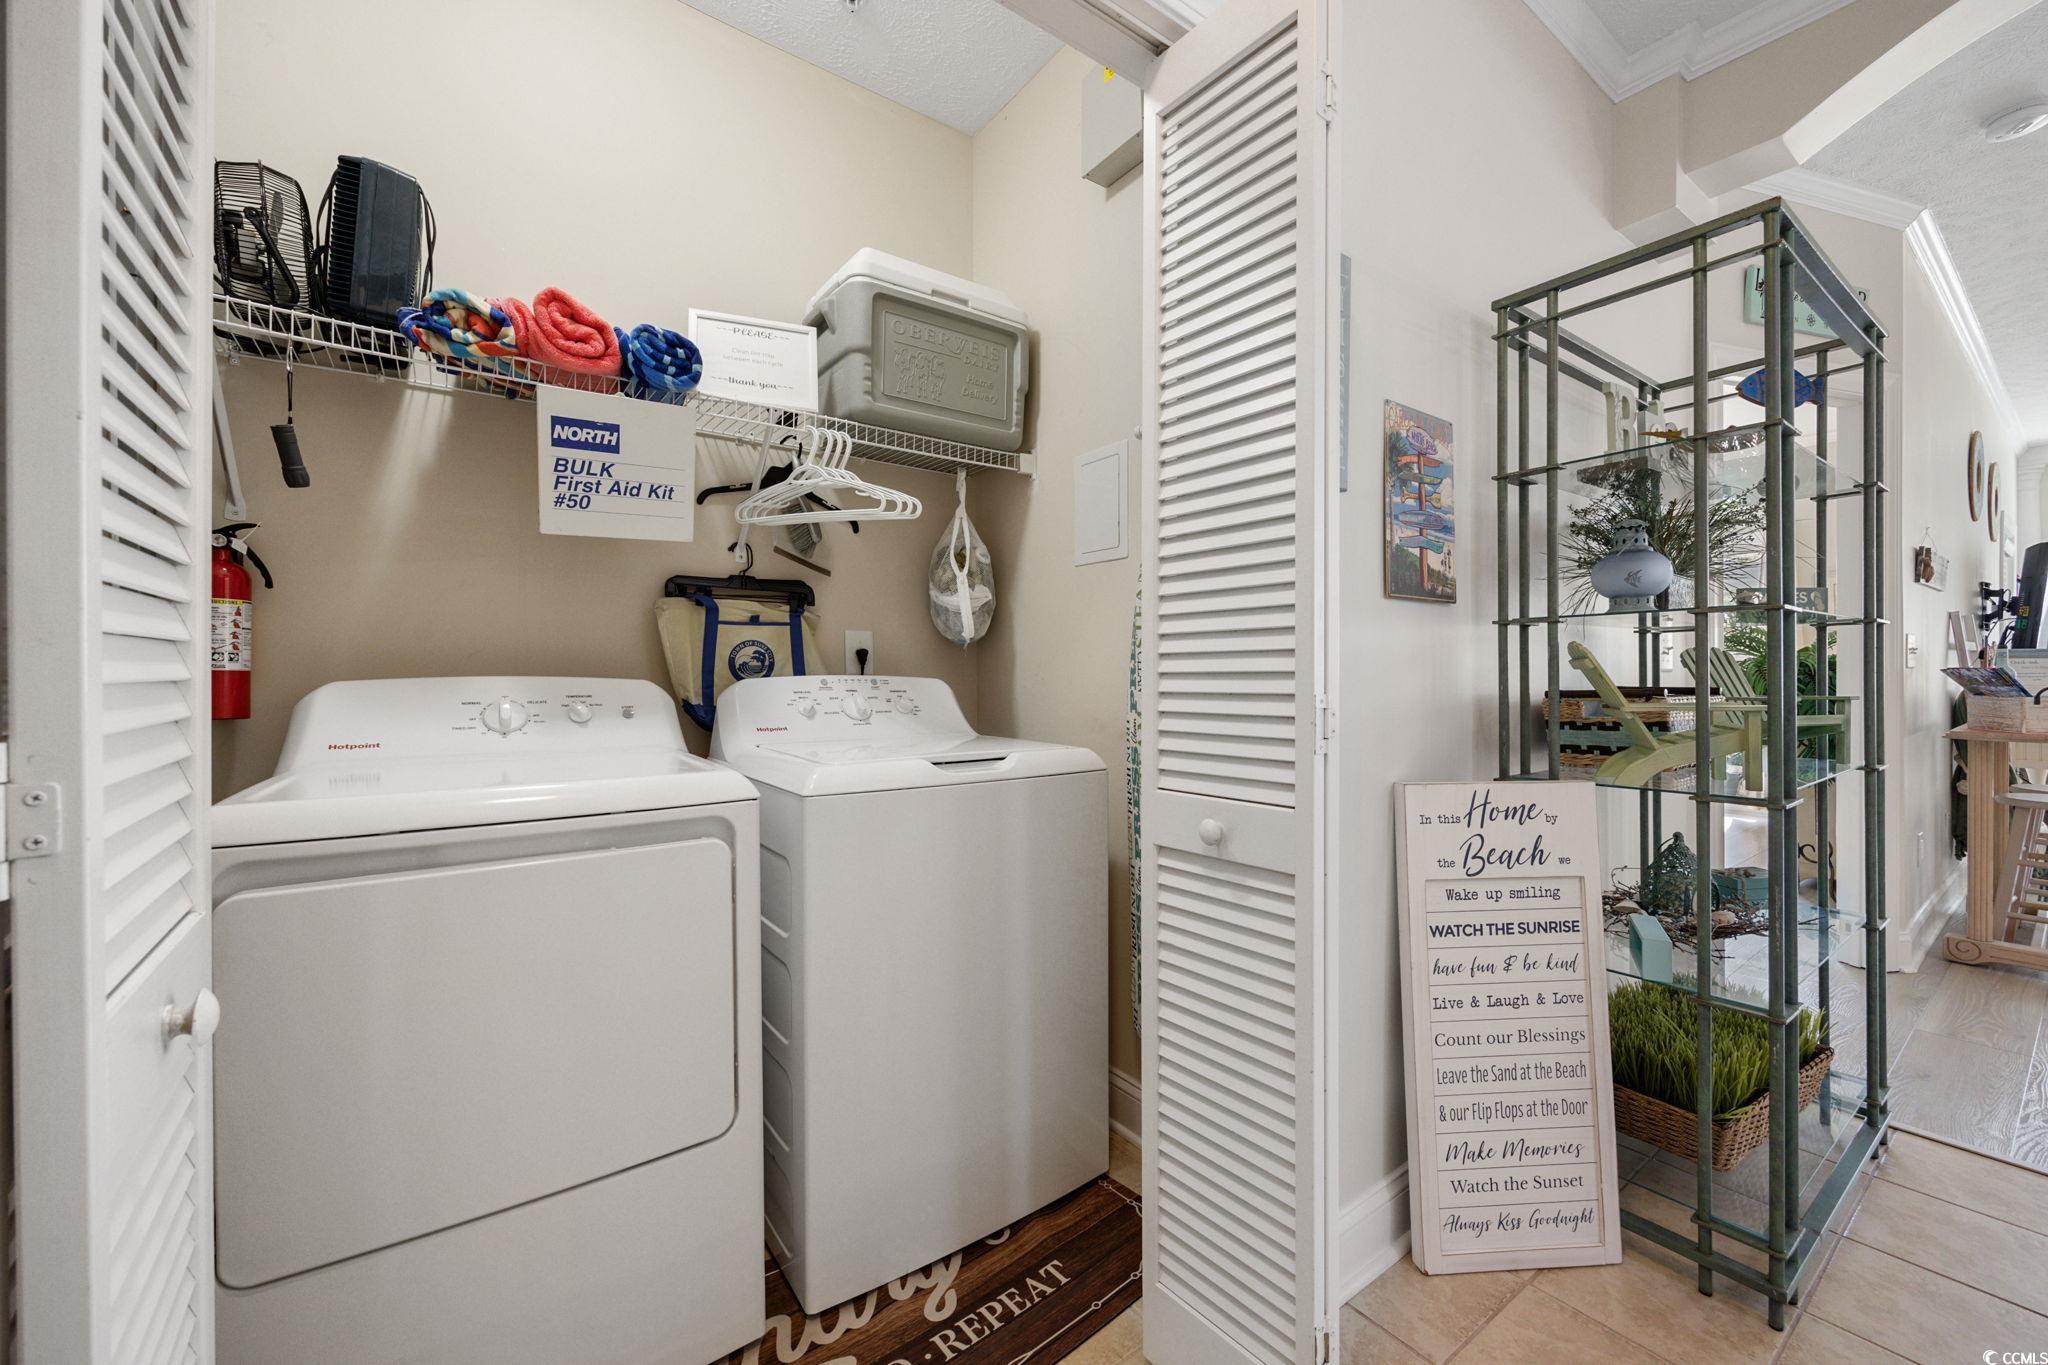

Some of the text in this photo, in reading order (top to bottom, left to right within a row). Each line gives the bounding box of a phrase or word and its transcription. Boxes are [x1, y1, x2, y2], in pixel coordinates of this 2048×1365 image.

[733, 327, 774, 340] PLEASE
[728, 376, 777, 390] thank you
[553, 424, 618, 445] NORTH
[553, 458, 615, 478] BULK
[554, 476, 675, 500] First Aid Kit
[554, 493, 591, 509] #50
[730, 643, 745, 658] TOWN
[754, 641, 768, 650] SURF
[328, 742, 381, 750] Hotpoint
[1420, 789, 1558, 829] In this Home by
[1437, 858, 1455, 868] the
[1460, 834, 1550, 877] Beach
[1445, 886, 1560, 902] Wake up smiling
[1429, 920, 1580, 938] WATCH THE SUNRISE
[1433, 953, 1579, 978] have fun & be kind
[1432, 992, 1584, 1010] Live & Laugh & Love
[1434, 1027, 1586, 1048] Count our Blessings
[1437, 1060, 1586, 1085] Leave the Sand at the Beach
[1439, 1098, 1588, 1124] & our Flip Flops at the Door
[1445, 1138, 1584, 1165] Make Memories
[1450, 1175, 1584, 1194] Watch the Sunset
[1443, 1208, 1594, 1238] Always Kiss Goodnight
[929, 1259, 1071, 1362] REPEAT
